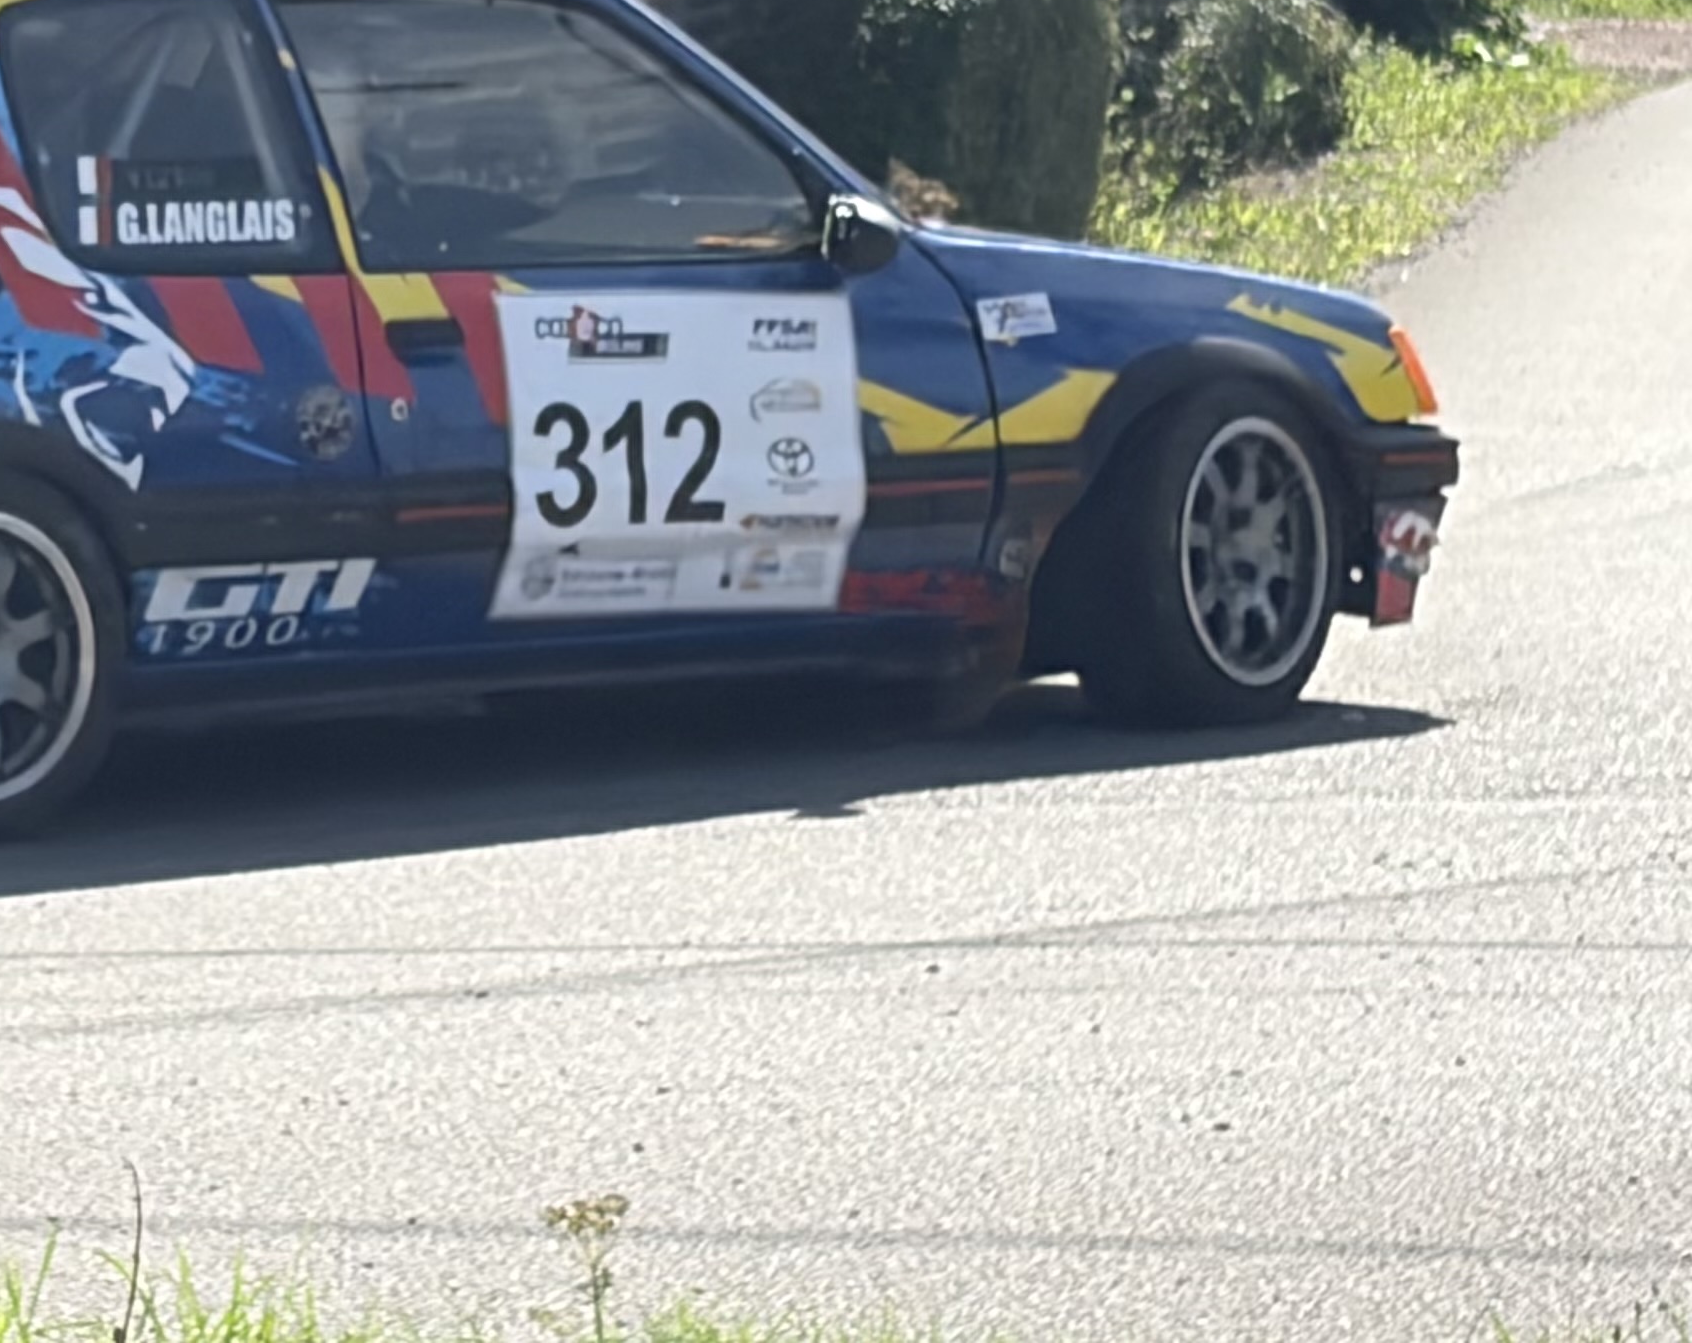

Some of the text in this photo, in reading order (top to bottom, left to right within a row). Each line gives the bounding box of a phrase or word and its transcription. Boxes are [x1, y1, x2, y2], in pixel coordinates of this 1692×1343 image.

[116, 198, 296, 245] G.LANGLAIS
[533, 399, 726, 528] 312
[144, 557, 377, 622] GTI
[148, 614, 299, 655] 1900
